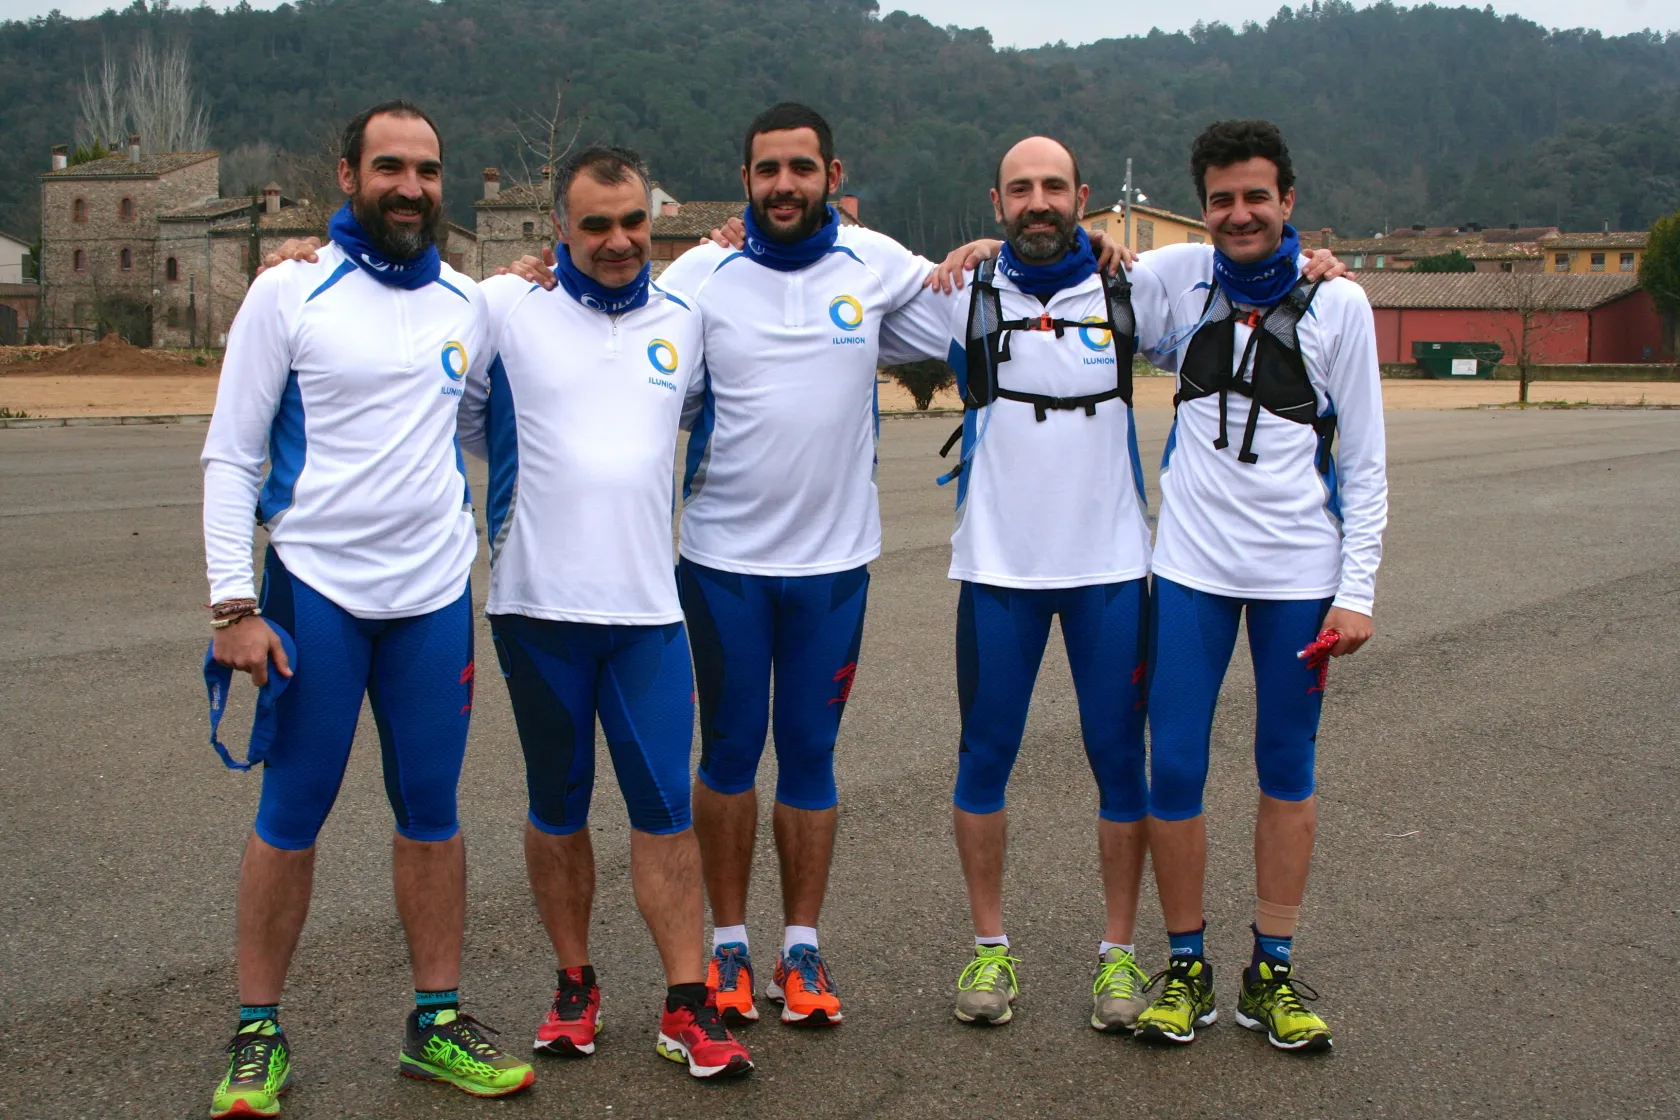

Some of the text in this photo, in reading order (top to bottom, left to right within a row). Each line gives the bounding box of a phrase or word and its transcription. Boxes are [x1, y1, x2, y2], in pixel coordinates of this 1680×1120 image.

[832, 337, 866, 345] ILUNION
[1083, 357, 1115, 365] ILUNION
[648, 376, 677, 392] ILUNION
